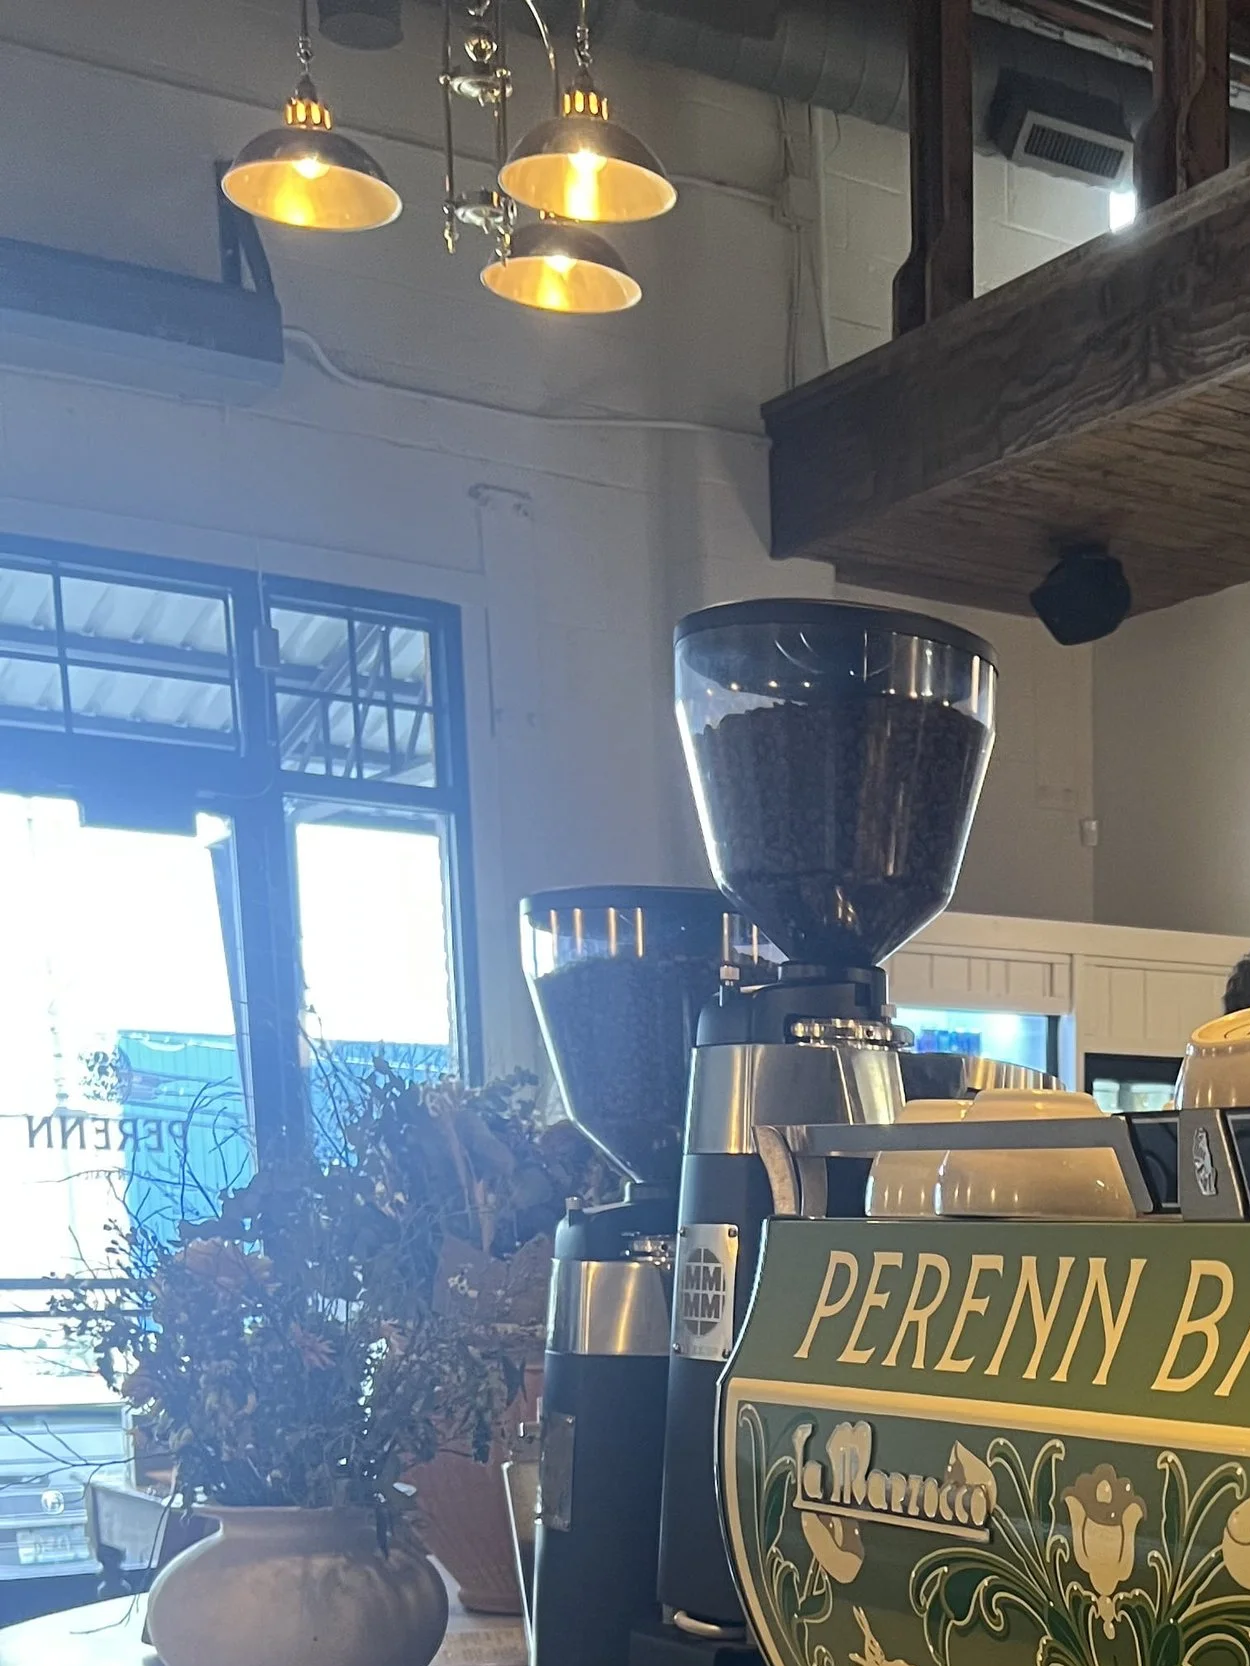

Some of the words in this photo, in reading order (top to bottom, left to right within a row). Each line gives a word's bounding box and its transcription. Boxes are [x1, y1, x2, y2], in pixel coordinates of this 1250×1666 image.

[793, 1250, 1148, 1385] PERENN
[792, 1423, 823, 1508] La
[826, 1420, 995, 1526] Marzocco
